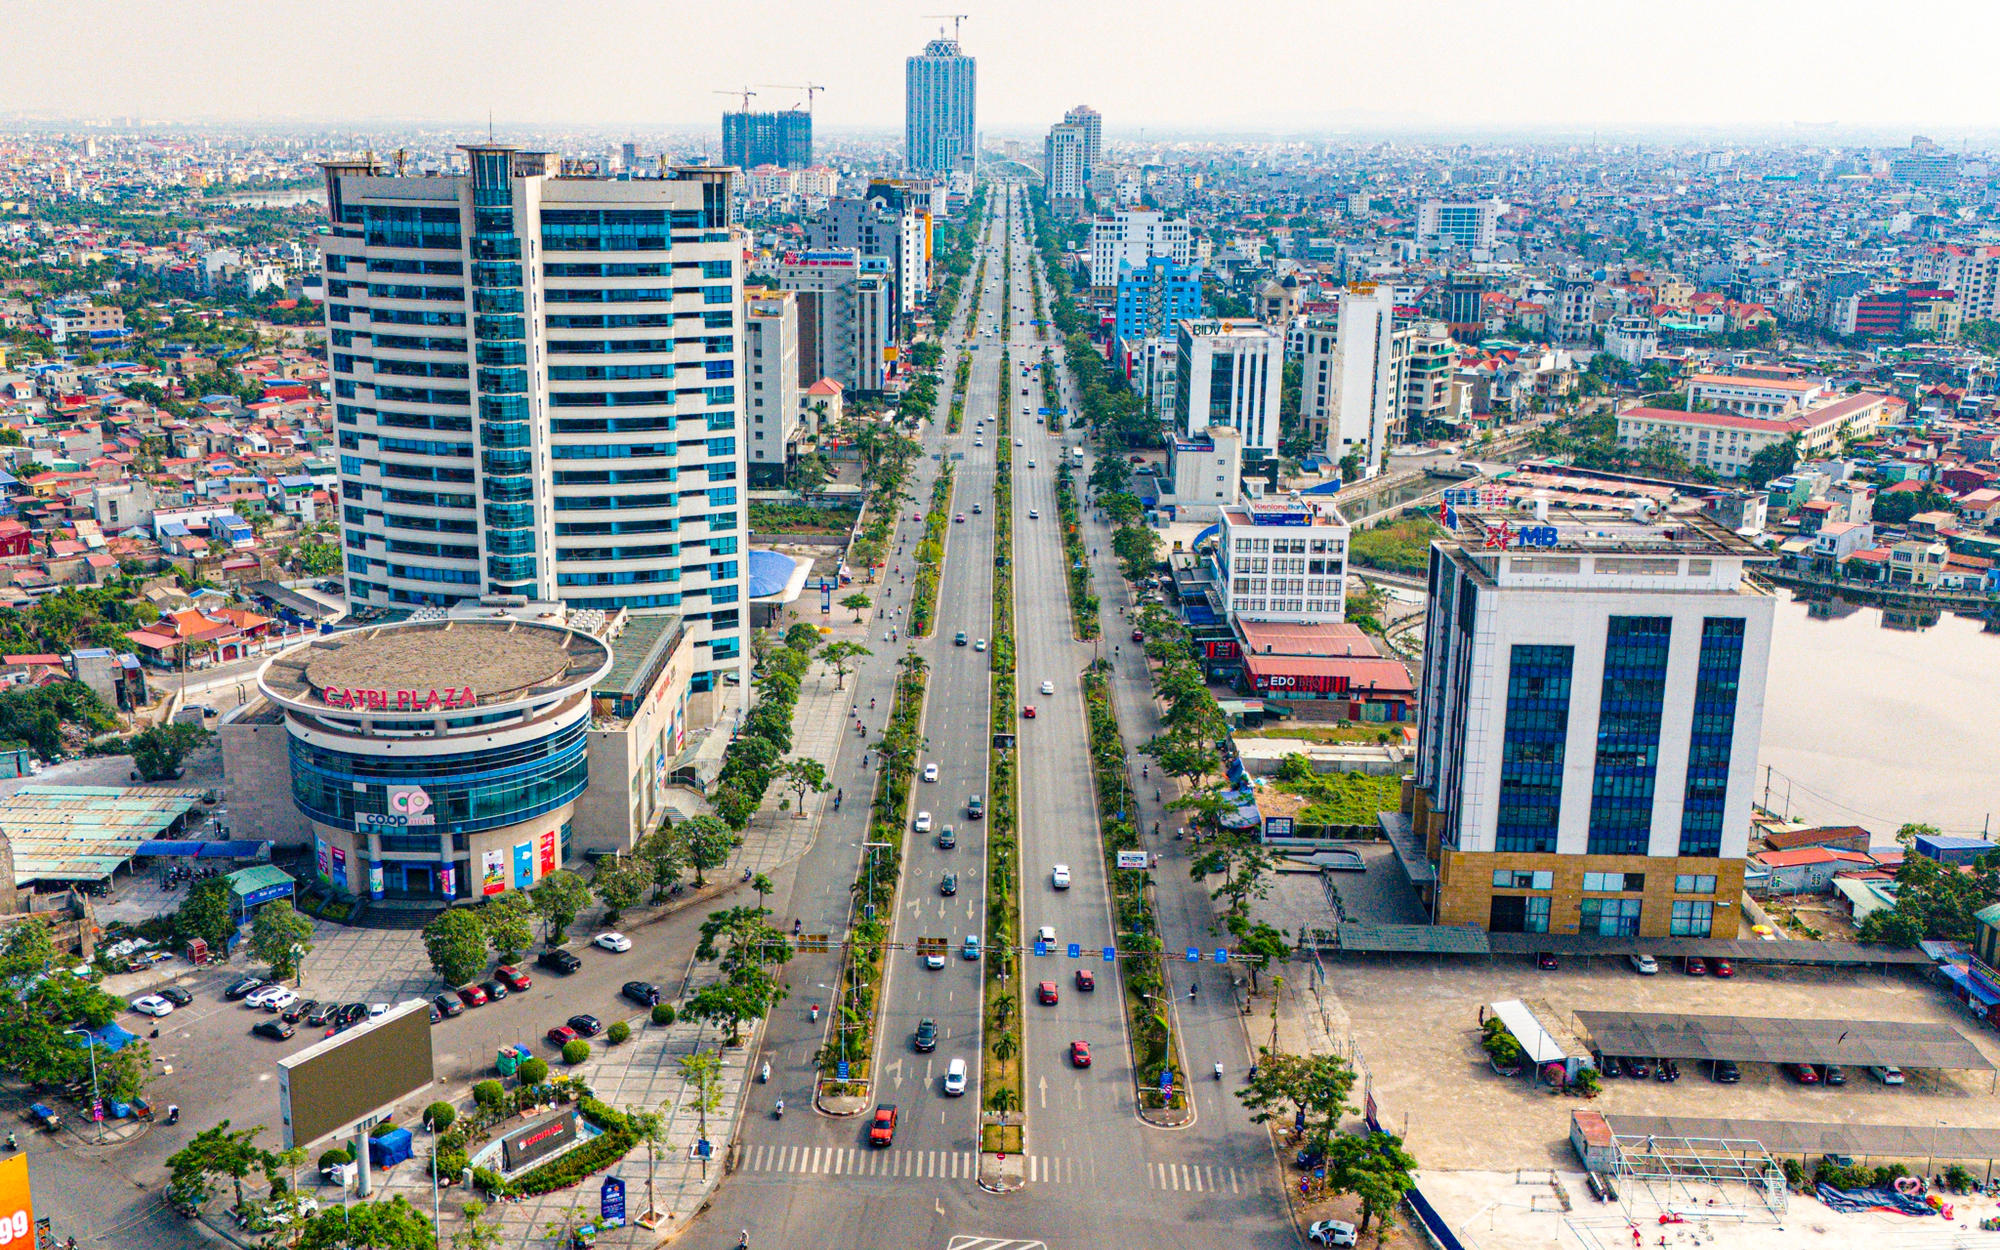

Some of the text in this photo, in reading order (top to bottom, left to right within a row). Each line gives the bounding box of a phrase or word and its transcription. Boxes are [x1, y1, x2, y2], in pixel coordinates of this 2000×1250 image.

[1193, 324, 1222, 336] BIDV
[1519, 526, 1558, 547] MB
[1270, 676, 1295, 686] EDO
[323, 686, 477, 709] CATBI PLAZA
